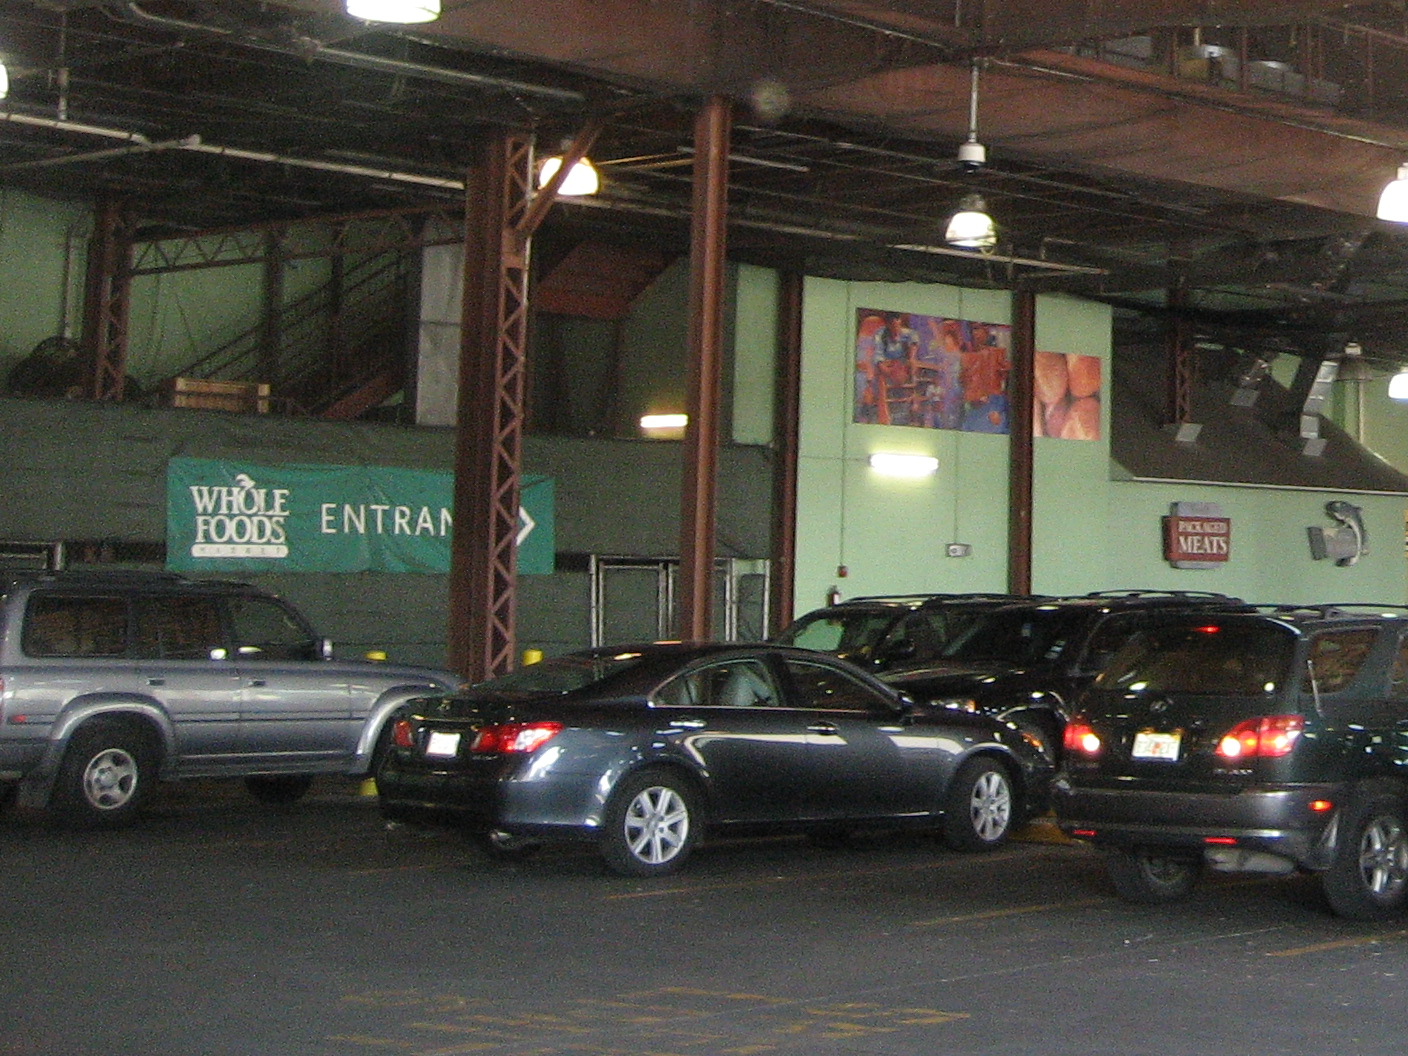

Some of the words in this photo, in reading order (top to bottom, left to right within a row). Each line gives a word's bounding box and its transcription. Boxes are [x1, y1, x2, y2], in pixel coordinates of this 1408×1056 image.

[190, 485, 290, 516] WHOLE
[195, 515, 286, 545] FOODS
[320, 502, 454, 537] ENTRAN
[1178, 535, 1229, 554] MEATS
